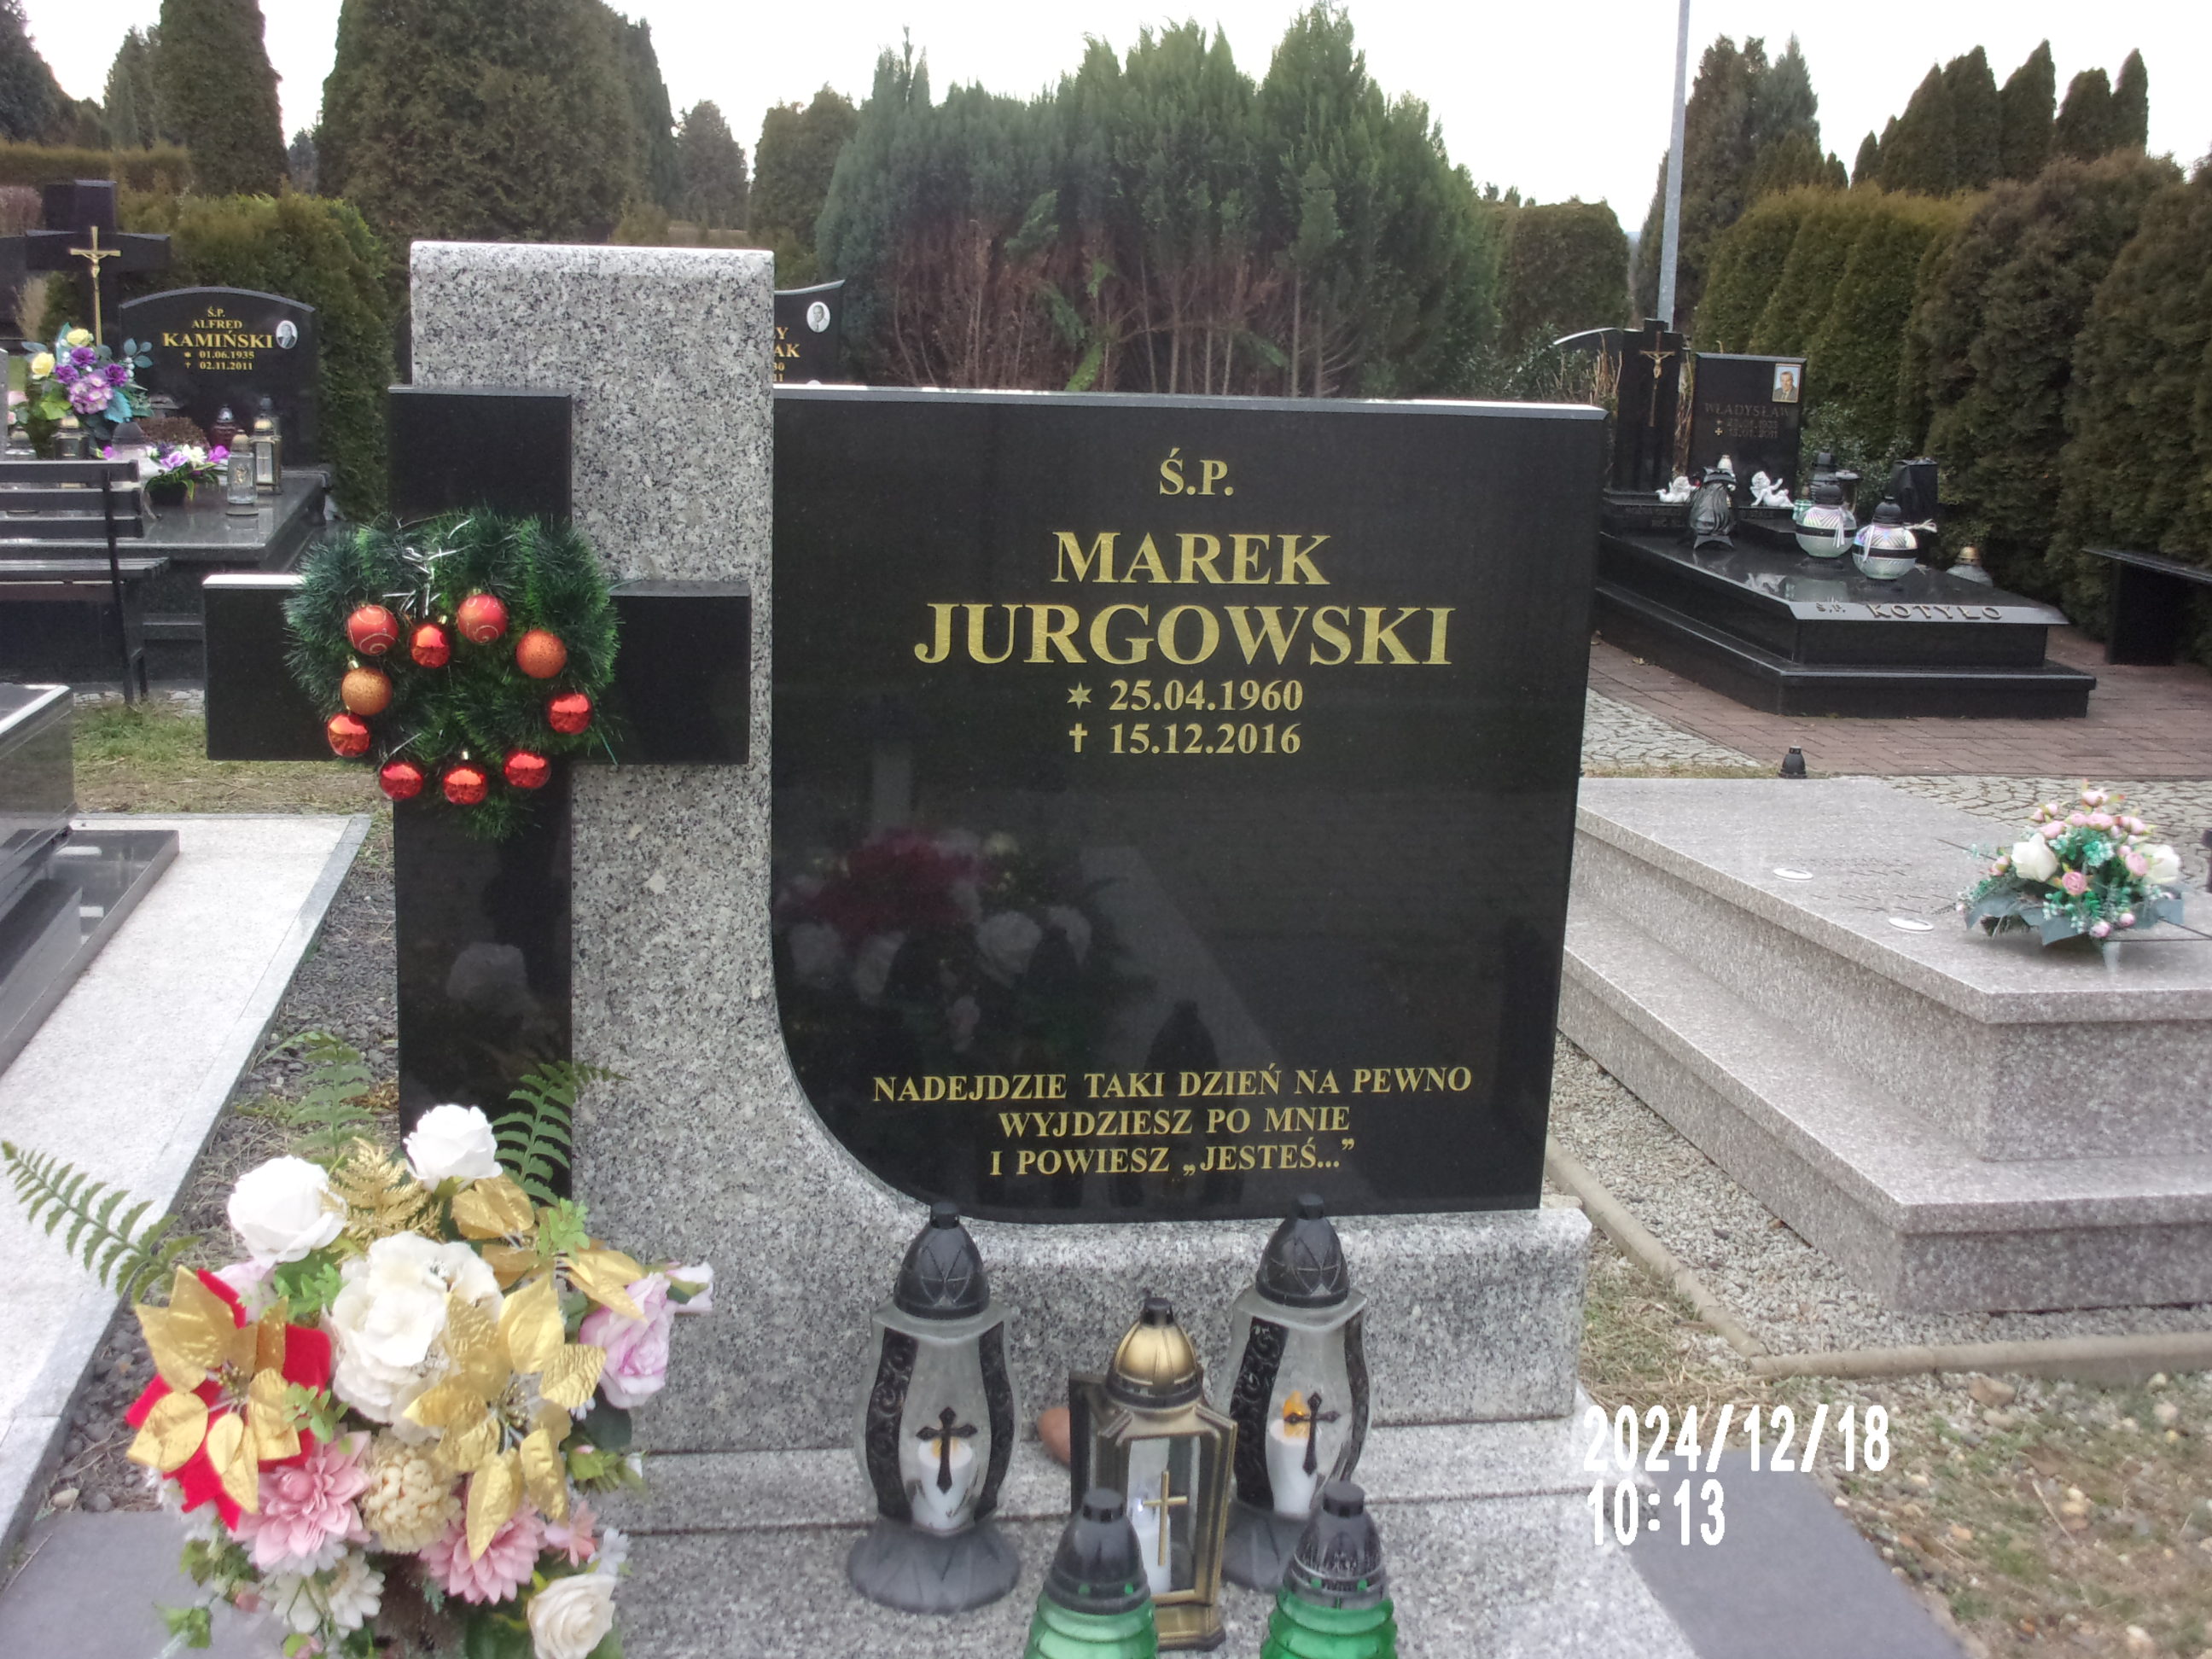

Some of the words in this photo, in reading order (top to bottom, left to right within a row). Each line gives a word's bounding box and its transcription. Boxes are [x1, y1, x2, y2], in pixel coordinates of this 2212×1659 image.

[191, 319, 243, 329] ALFRED
[207, 306, 226, 317] Ś.P.
[162, 329, 274, 349] KAMIŃSKI
[199, 350, 255, 359] 01.06.1935
[199, 361, 253, 370] 02.11.2011
[1159, 447, 1234, 496] Ś.P.
[1051, 531, 1331, 585] MAREK
[1866, 602, 2002, 620] KOTYŁO
[913, 602, 1456, 666] JURGOWSKI
[1108, 679, 1304, 712] 25.04.1960
[1109, 723, 1302, 754] 15.12.2016
[873, 1073, 1068, 1102] NADEJDZIE
[1083, 1071, 1166, 1098] TAKI
[1178, 1062, 1282, 1097] DZIEŃ
[1294, 1068, 1341, 1095] NA
[1351, 1066, 1472, 1093] PEWNO
[998, 1109, 1193, 1138] WYJDZIESZ
[1206, 1108, 1251, 1134] PO
[1263, 1106, 1351, 1132] MNIE
[989, 1150, 1004, 1176] I
[1016, 1146, 1170, 1176] POWIESZ
